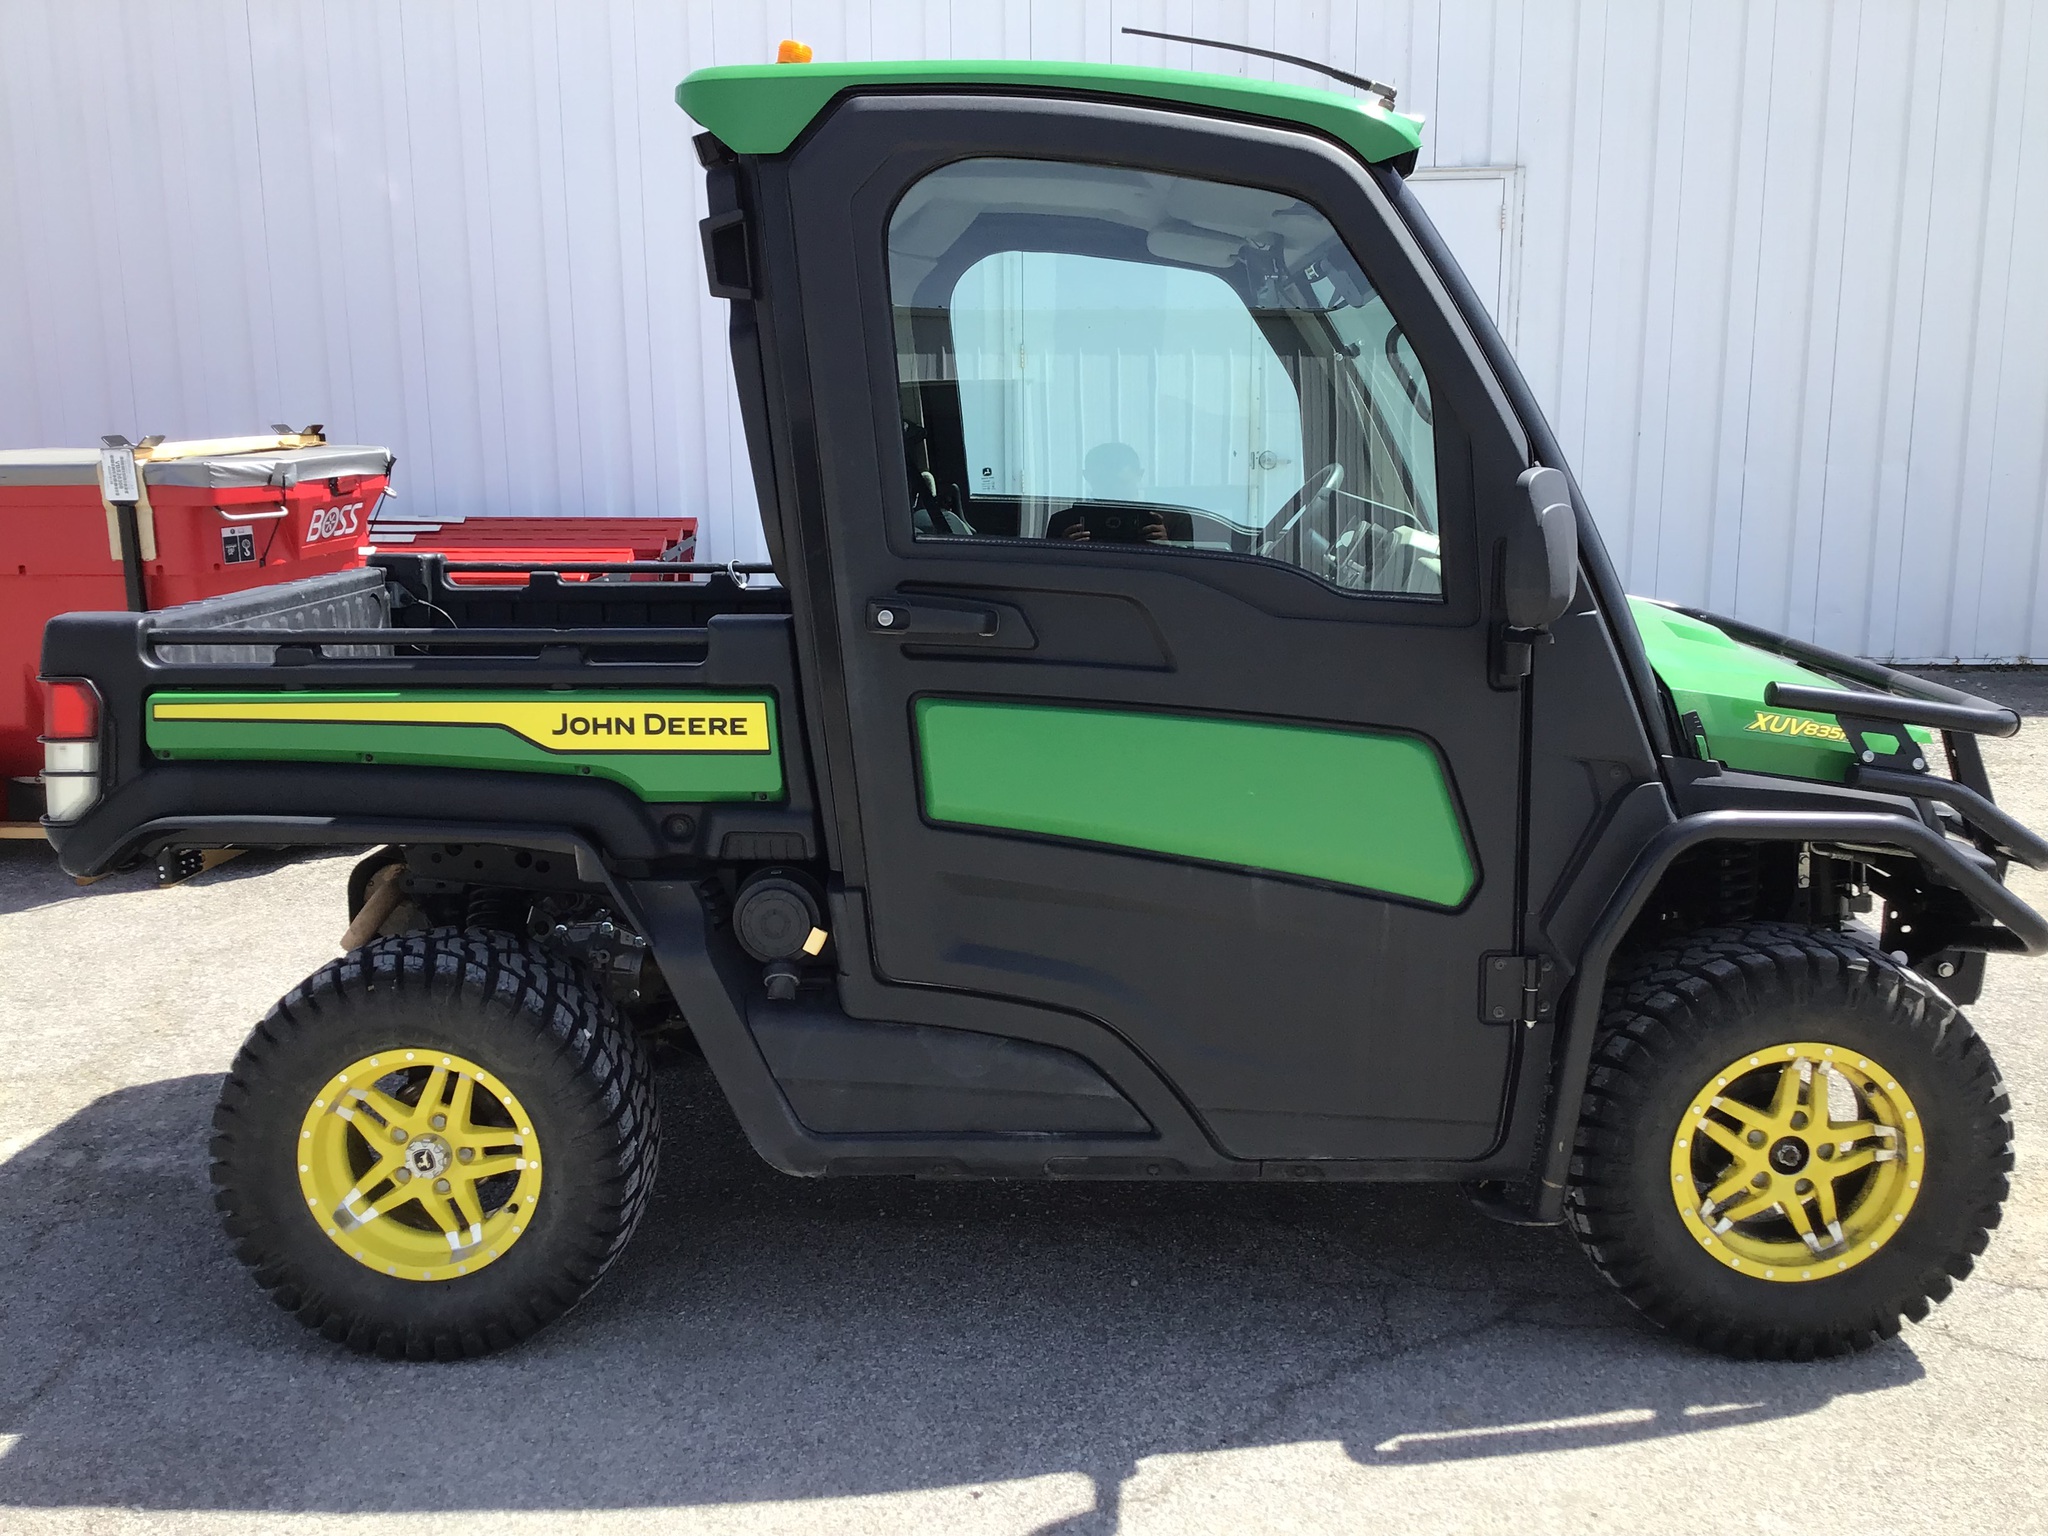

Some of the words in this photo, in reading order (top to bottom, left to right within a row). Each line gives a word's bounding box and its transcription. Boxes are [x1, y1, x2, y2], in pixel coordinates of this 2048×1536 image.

[306, 502, 363, 543] BOSS
[552, 713, 635, 736] JOHN
[644, 713, 748, 736] DEERE
